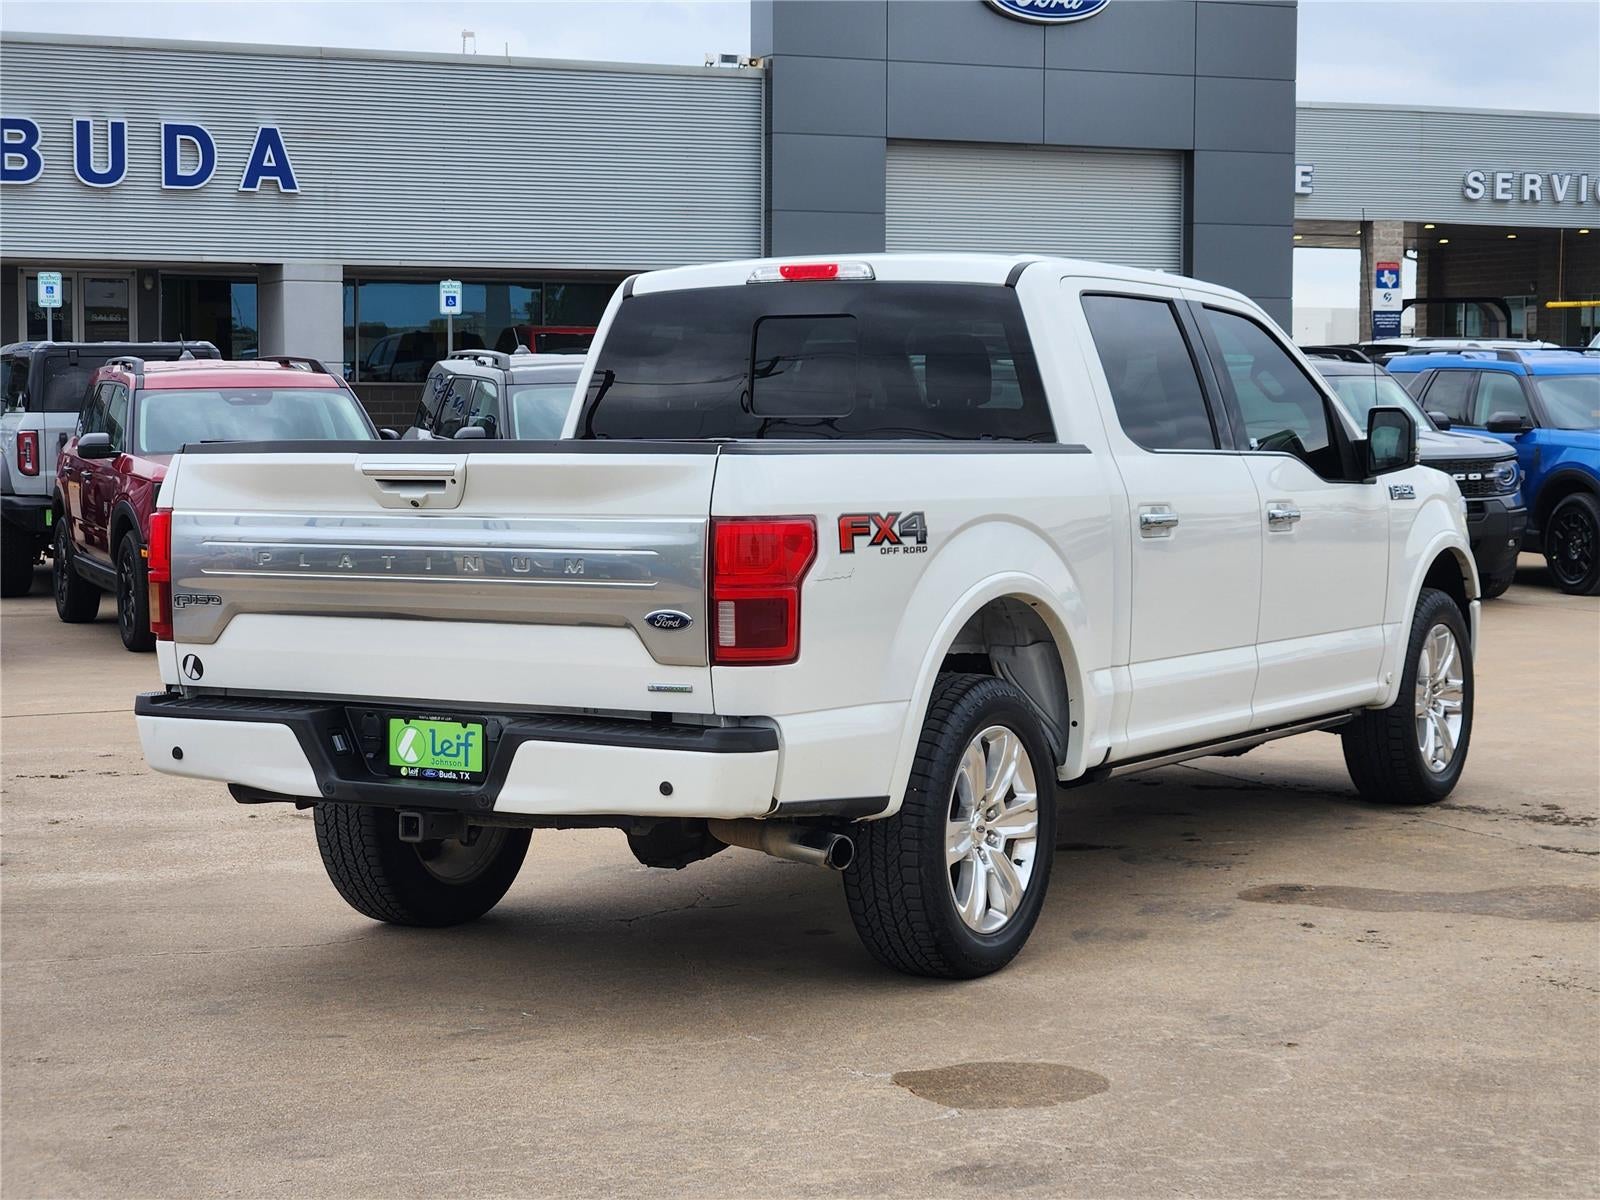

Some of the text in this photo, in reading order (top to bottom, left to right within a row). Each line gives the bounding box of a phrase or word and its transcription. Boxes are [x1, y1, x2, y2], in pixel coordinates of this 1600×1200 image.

[0, 117, 300, 194] BUDA
[1464, 169, 1600, 203] SERVI
[34, 312, 65, 320] SAES
[838, 511, 928, 554] FX4
[880, 545, 928, 555] OFF ROAD
[256, 551, 585, 575] PLATINUM
[654, 614, 681, 628] Ford
[431, 758, 462, 767] Johnson
[459, 771, 470, 780] TX
